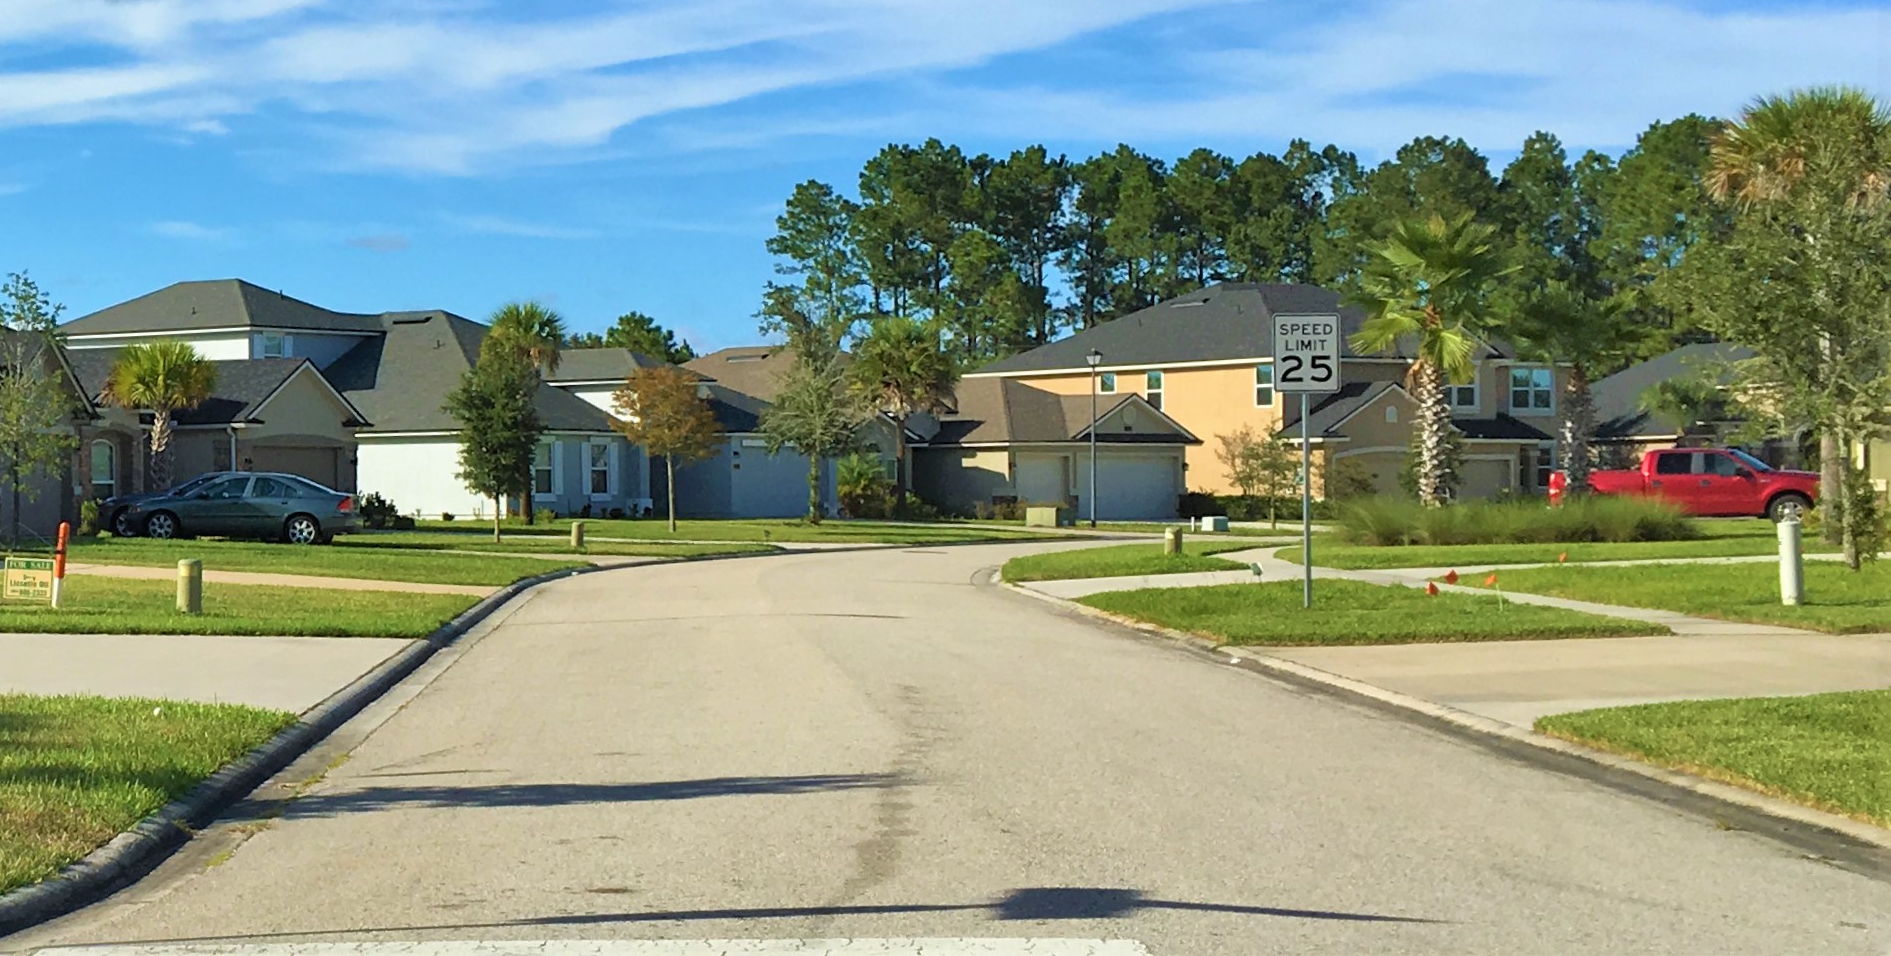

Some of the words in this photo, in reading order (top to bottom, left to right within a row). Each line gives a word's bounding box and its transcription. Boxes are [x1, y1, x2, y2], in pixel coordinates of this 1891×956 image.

[1279, 323, 1333, 336] SPEED
[1285, 339, 1327, 352] LIMIT
[1280, 355, 1333, 382] 25
[9, 560, 26, 568] FOR
[30, 561, 51, 569] SALE
